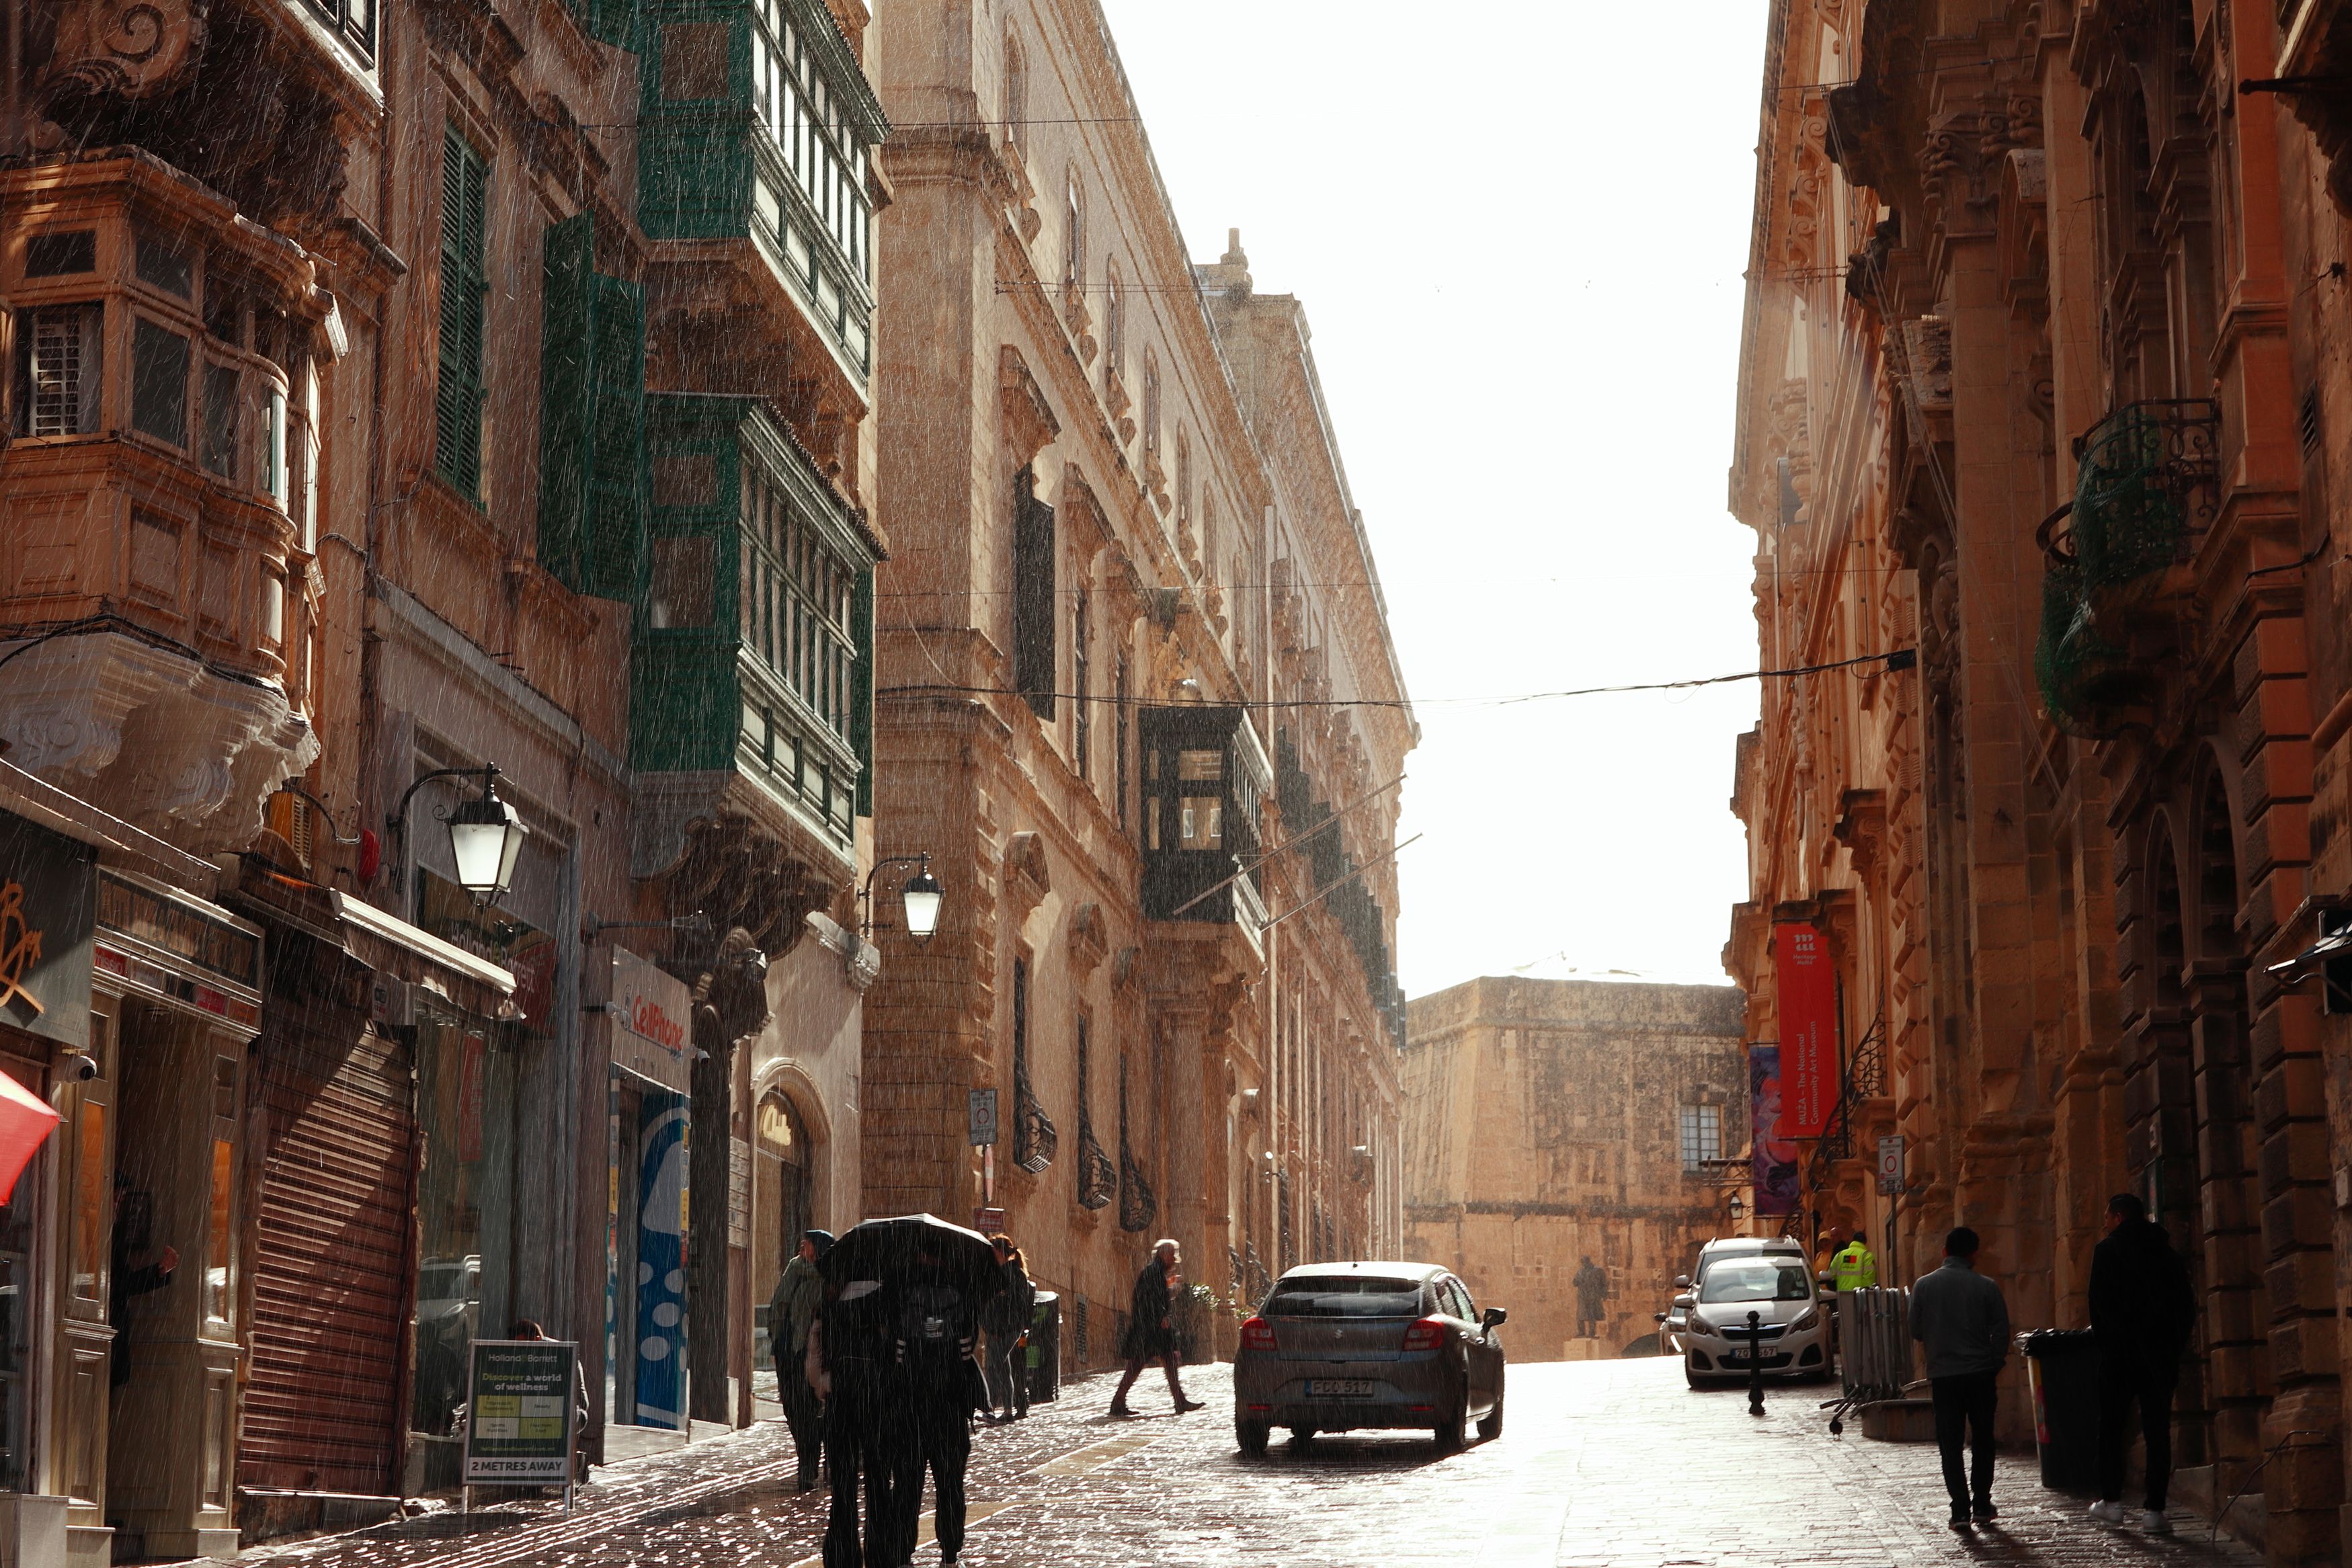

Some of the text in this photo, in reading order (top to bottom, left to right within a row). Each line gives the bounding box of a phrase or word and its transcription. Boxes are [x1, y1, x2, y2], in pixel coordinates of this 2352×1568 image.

[1796, 1033, 1806, 1071] National
[1809, 1021, 1820, 1124] Community Art Museum
[1797, 1073, 1806, 1089] The
[489, 1354, 521, 1362] Holland
[482, 1372, 524, 1381] Discover
[494, 1383, 549, 1391] of wellness
[1345, 1381, 1369, 1393] 517
[472, 1461, 562, 1471] 2 METRES AWAY
